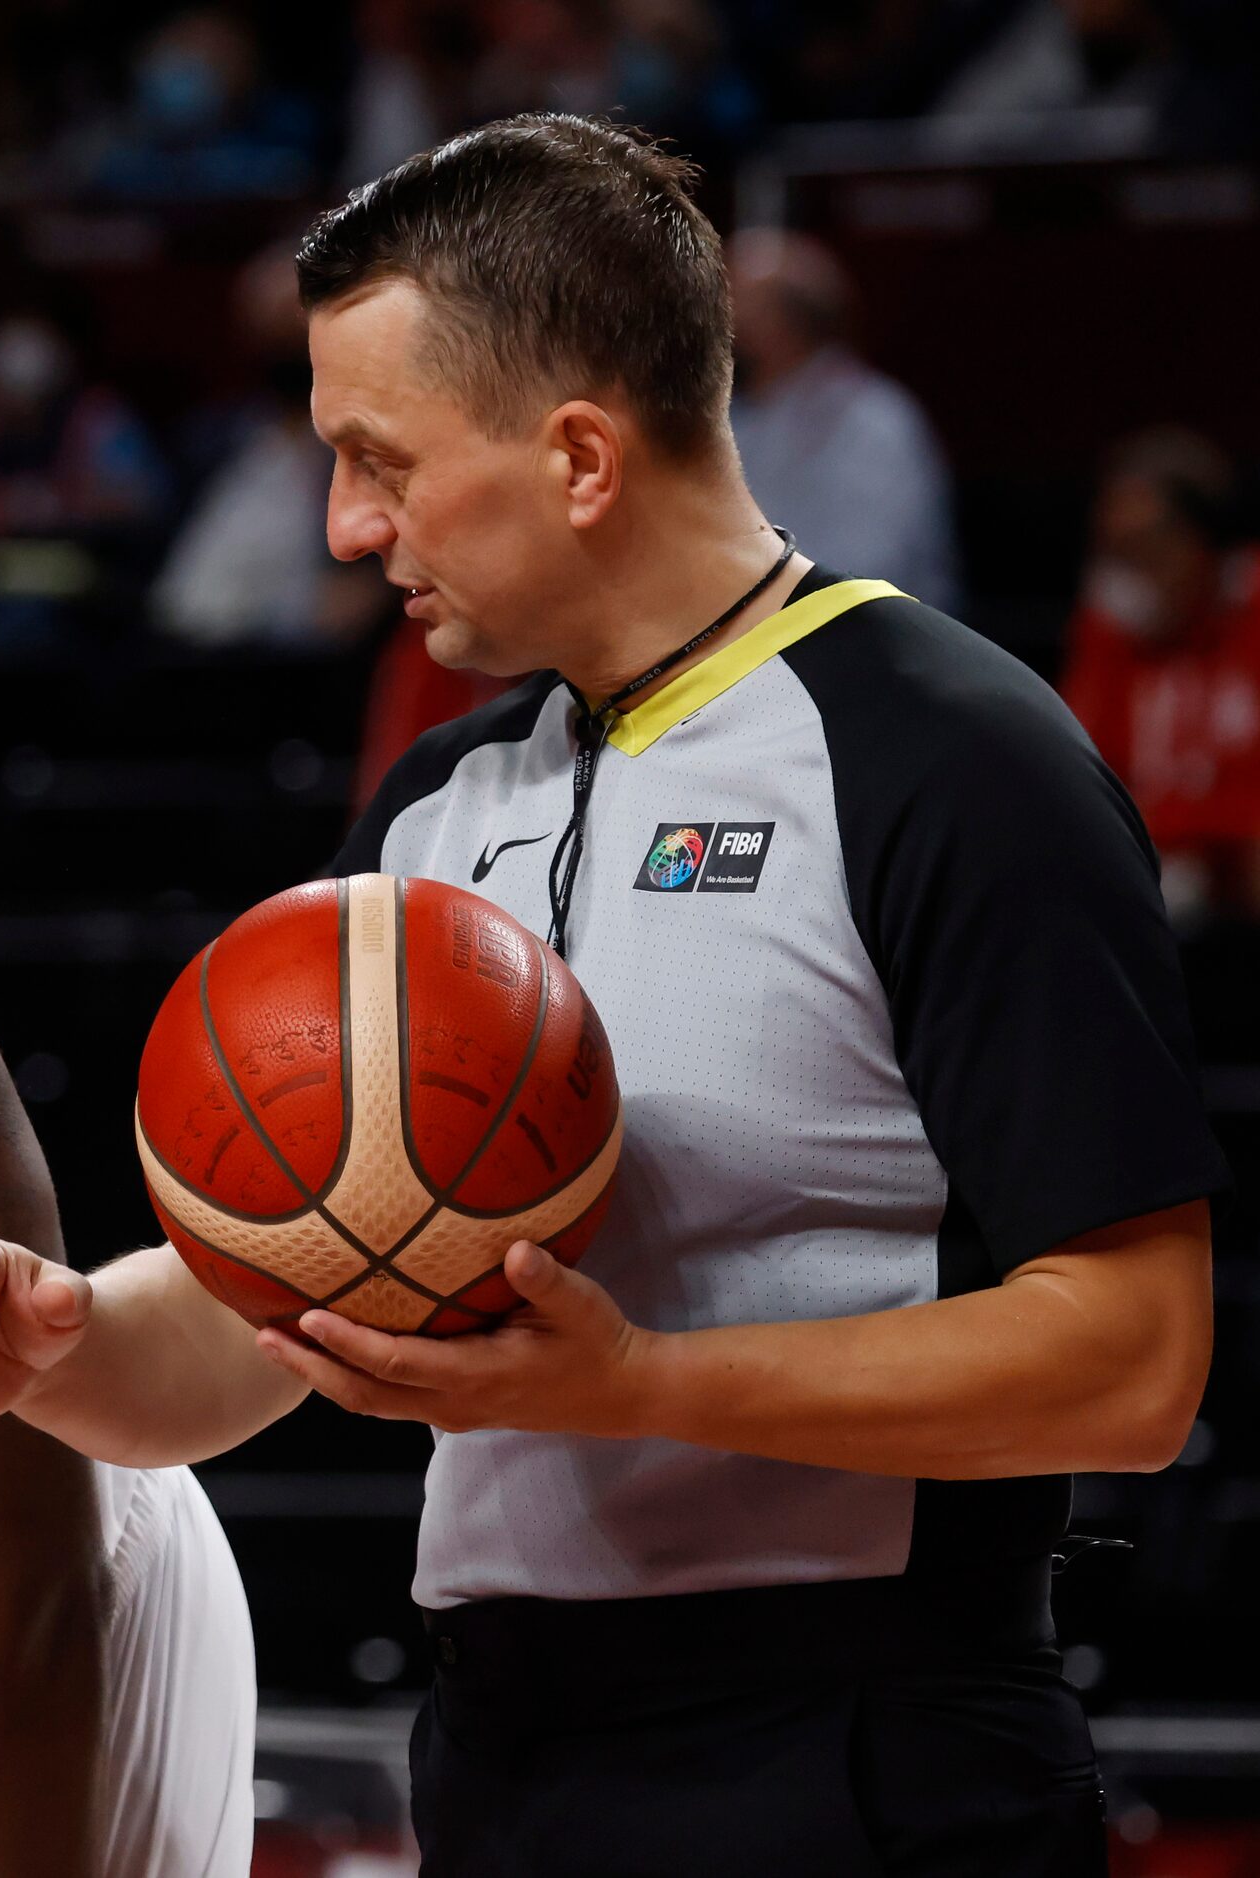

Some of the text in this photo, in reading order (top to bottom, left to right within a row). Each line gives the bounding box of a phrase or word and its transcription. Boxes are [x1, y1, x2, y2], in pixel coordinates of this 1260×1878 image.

[575, 756, 584, 791] FOX40
[718, 831, 764, 856] FIBA
[706, 875, 754, 884] We Are Basketball
